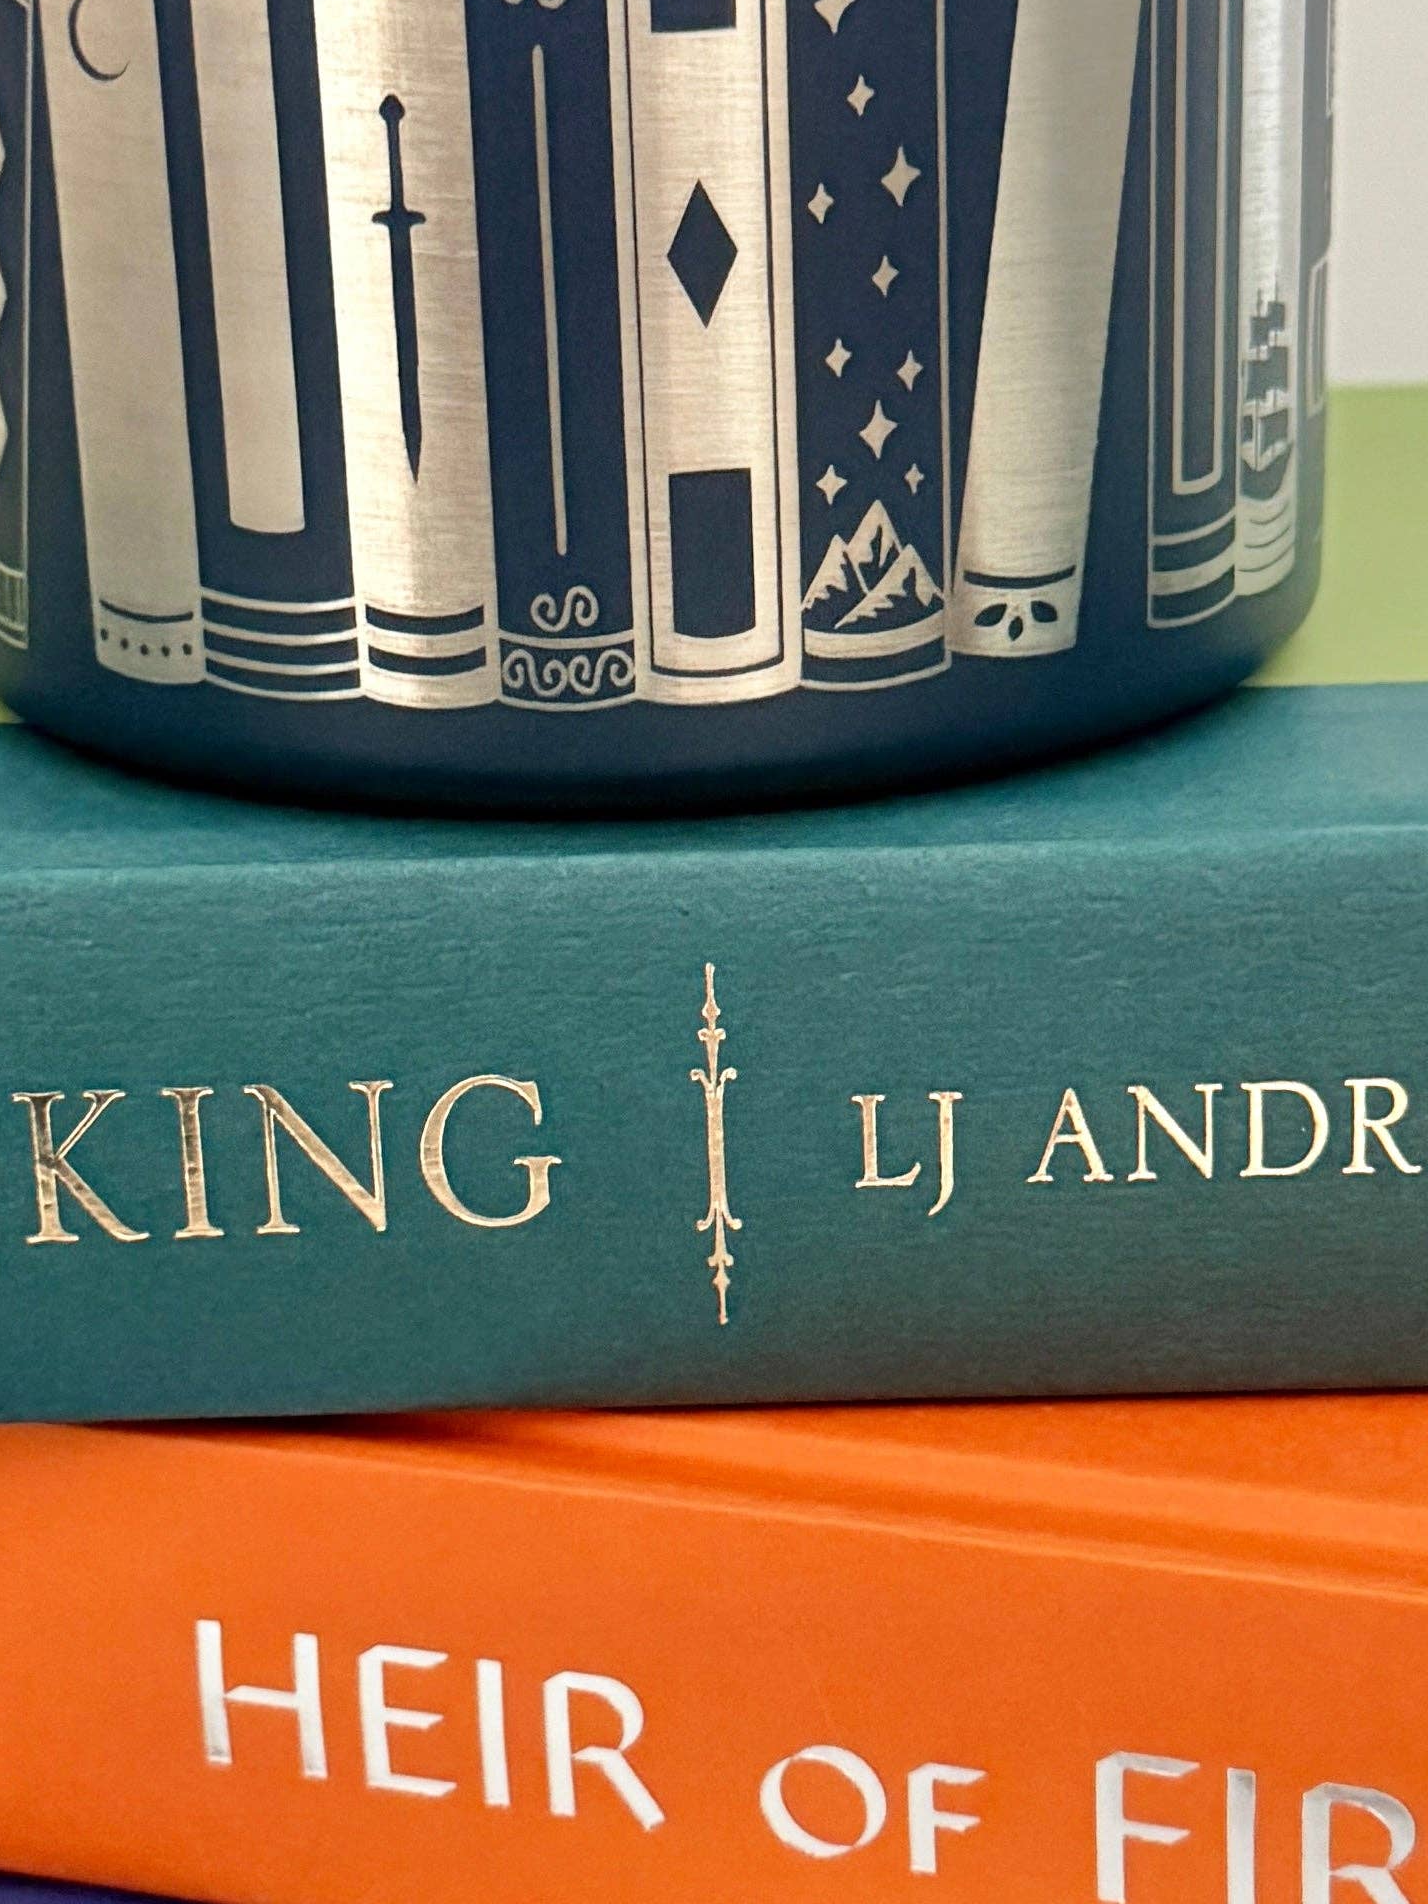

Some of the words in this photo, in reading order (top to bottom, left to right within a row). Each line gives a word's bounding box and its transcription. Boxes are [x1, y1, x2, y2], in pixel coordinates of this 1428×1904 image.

[12, 1074, 563, 1244] KING
[850, 1091, 963, 1217] LJ
[196, 1619, 665, 1832] HEIR
[759, 1743, 988, 1875] OF
